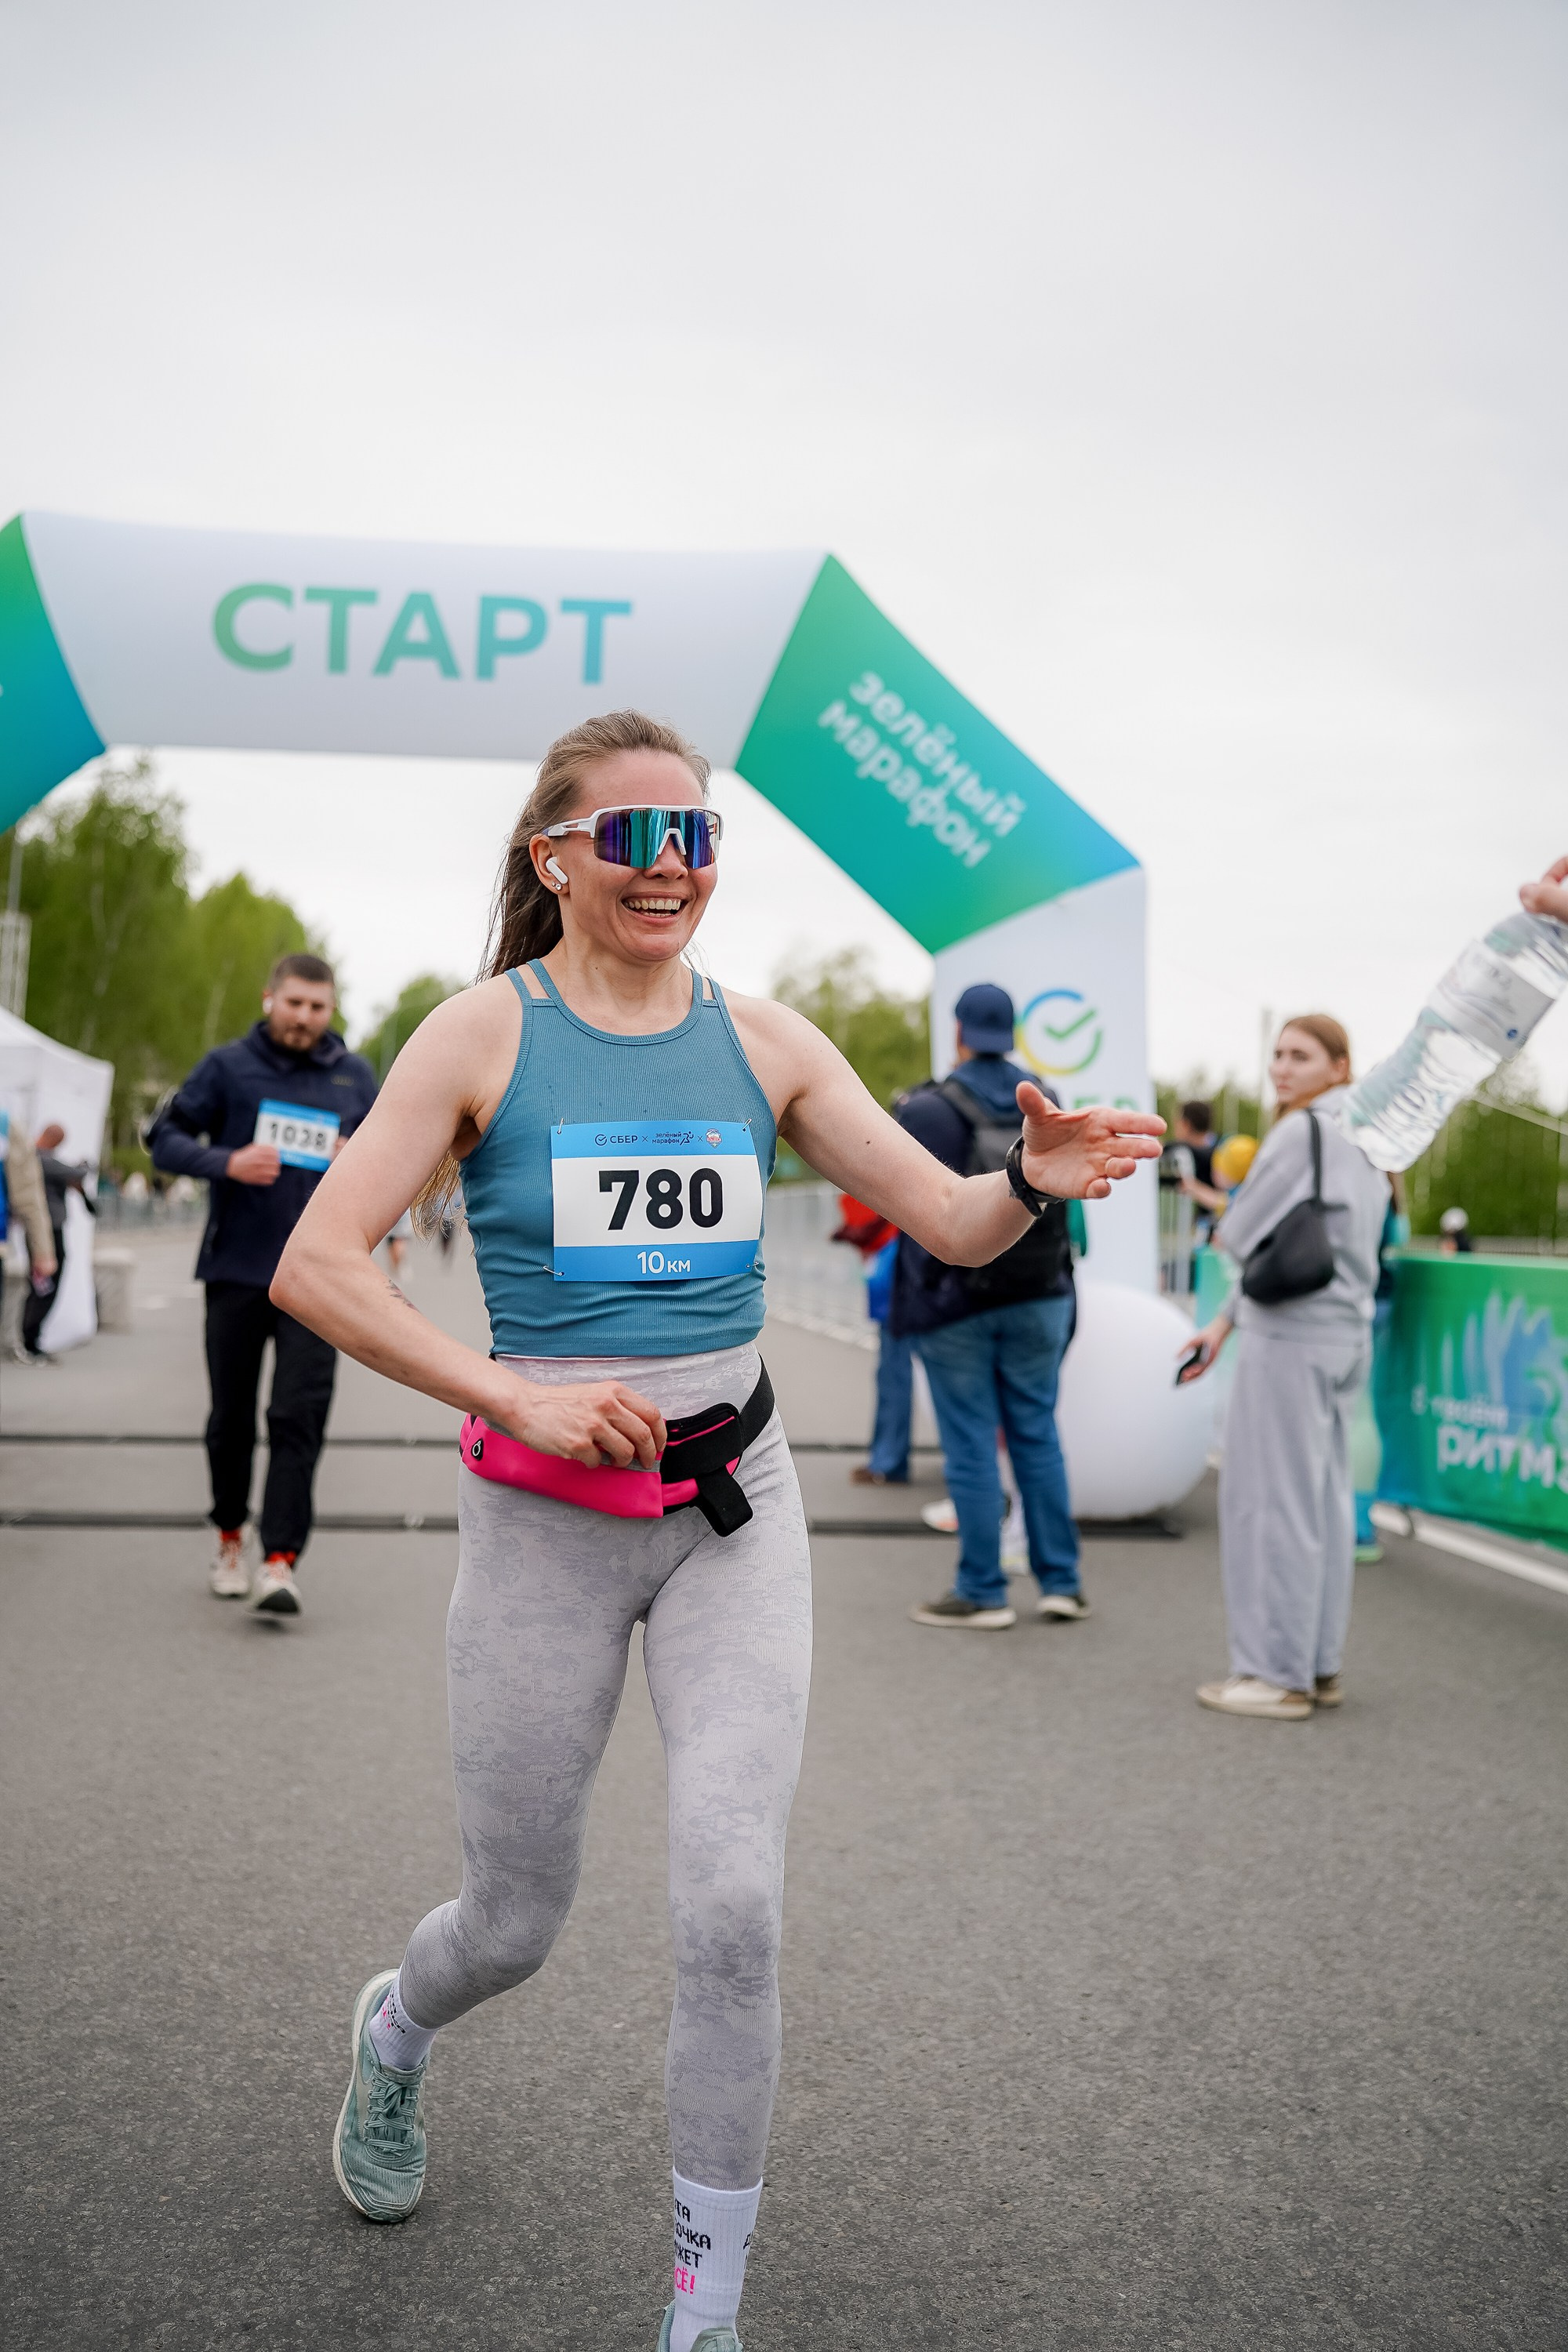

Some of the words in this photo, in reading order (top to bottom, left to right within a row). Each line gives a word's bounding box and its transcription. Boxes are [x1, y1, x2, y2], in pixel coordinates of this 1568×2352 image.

[212, 583, 633, 686] СТАРТ
[817, 699, 991, 869] марафон
[610, 1135, 638, 1145] СБЕР
[598, 1167, 724, 1231] 780
[637, 1250, 665, 1274] 10
[674, 2198, 690, 2223] ТА
[674, 2217, 711, 2250] ОЧКА
[674, 2267, 695, 2295] СЁ!
